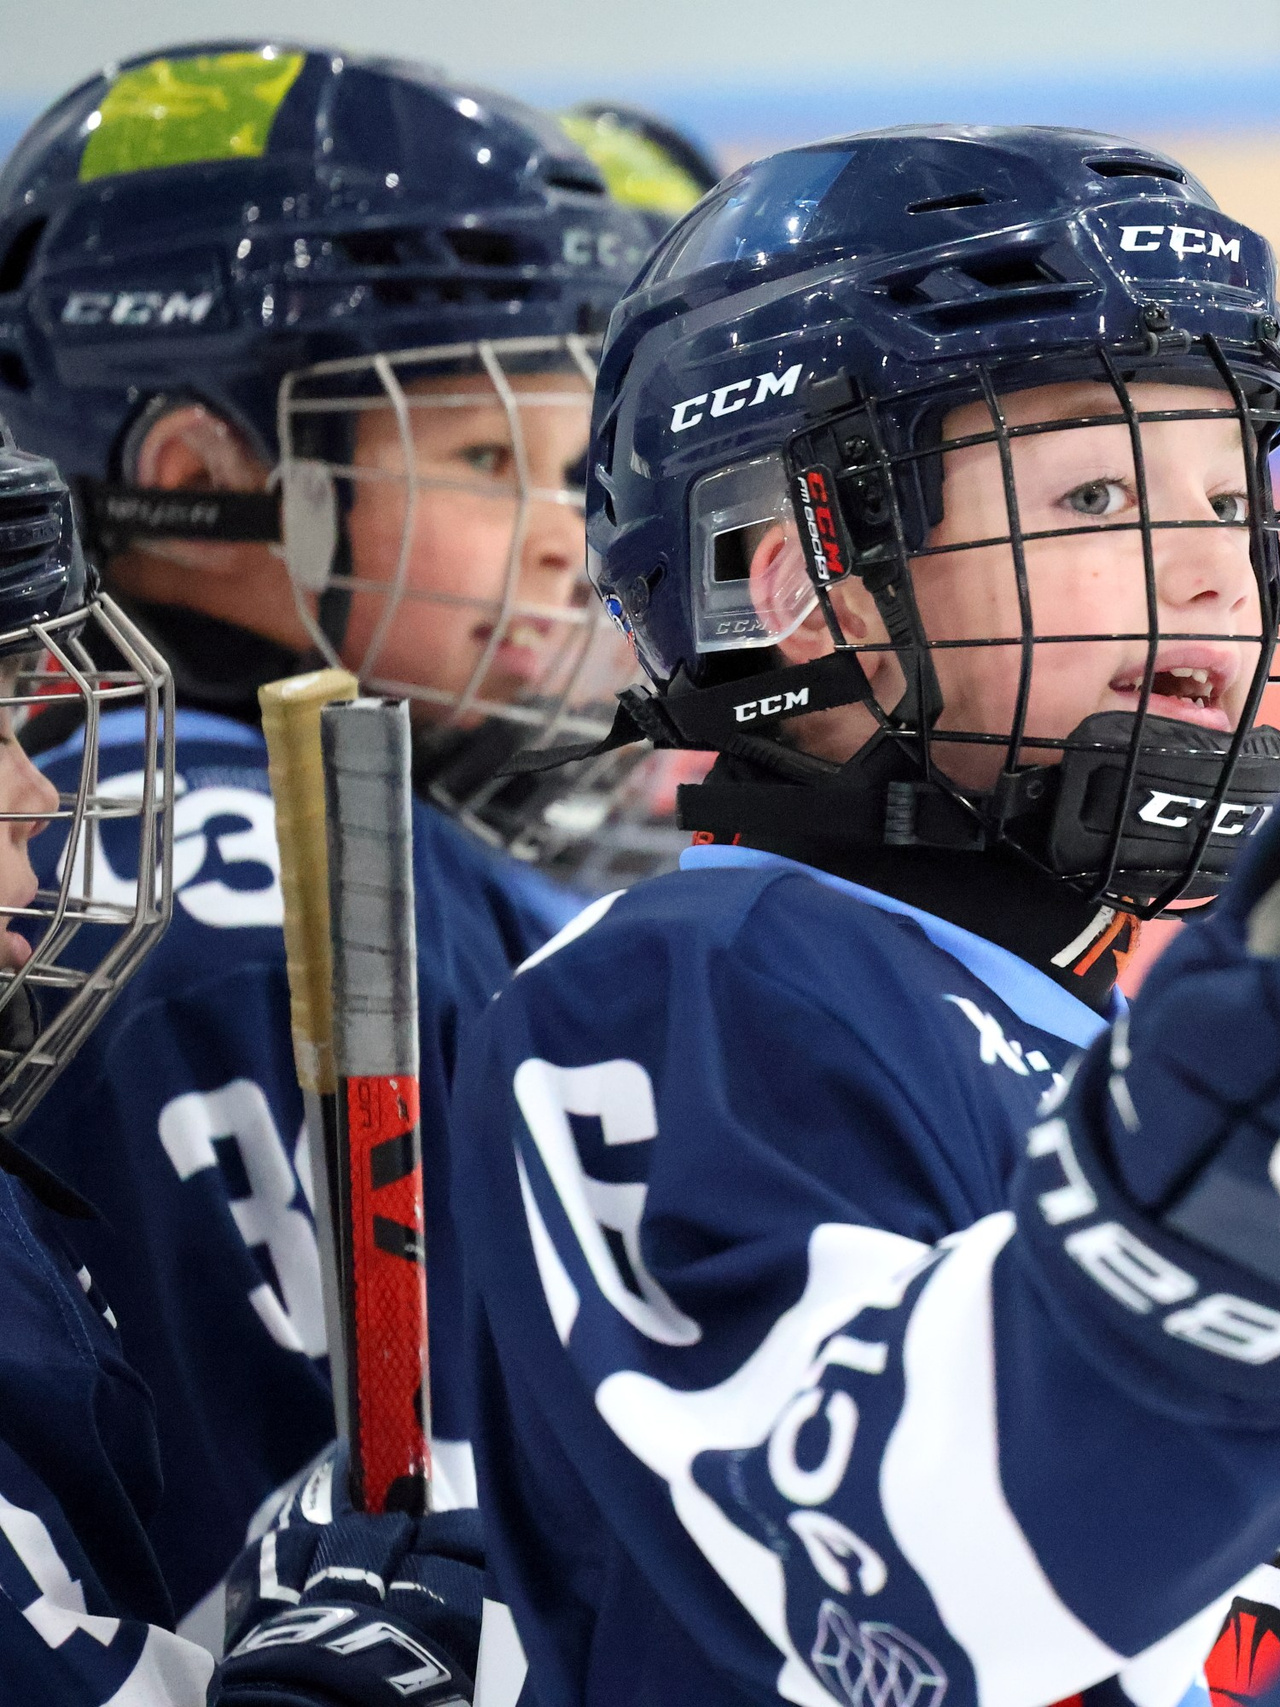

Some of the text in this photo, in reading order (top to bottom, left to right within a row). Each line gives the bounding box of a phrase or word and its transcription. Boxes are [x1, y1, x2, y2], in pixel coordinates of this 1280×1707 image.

[563, 228, 642, 267] CC
[1118, 225, 1241, 263] CCM
[61, 291, 213, 325] CCM
[670, 364, 803, 433] CCM
[807, 471, 844, 573] CCM
[715, 619, 769, 635] CCM
[732, 687, 809, 722] CCM
[1138, 790, 1274, 836] CC
